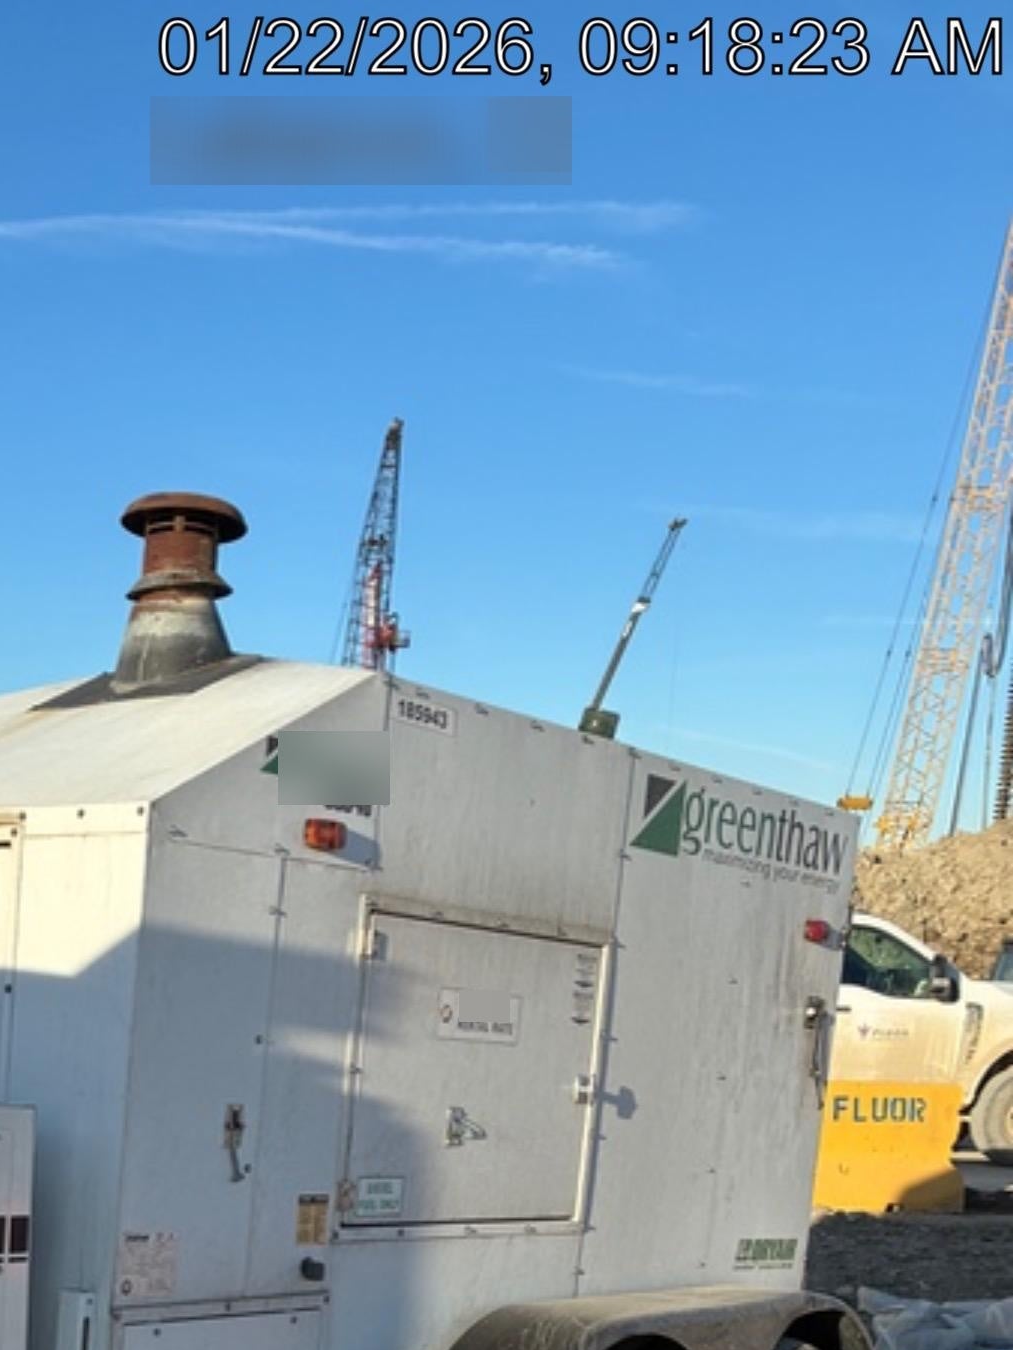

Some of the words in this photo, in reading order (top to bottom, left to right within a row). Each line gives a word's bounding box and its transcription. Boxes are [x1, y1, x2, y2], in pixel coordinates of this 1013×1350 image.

[398, 700, 448, 729] 185943
[681, 785, 849, 874] greenthaw
[773, 865, 799, 882] your
[833, 1095, 928, 1123] FLUOR
